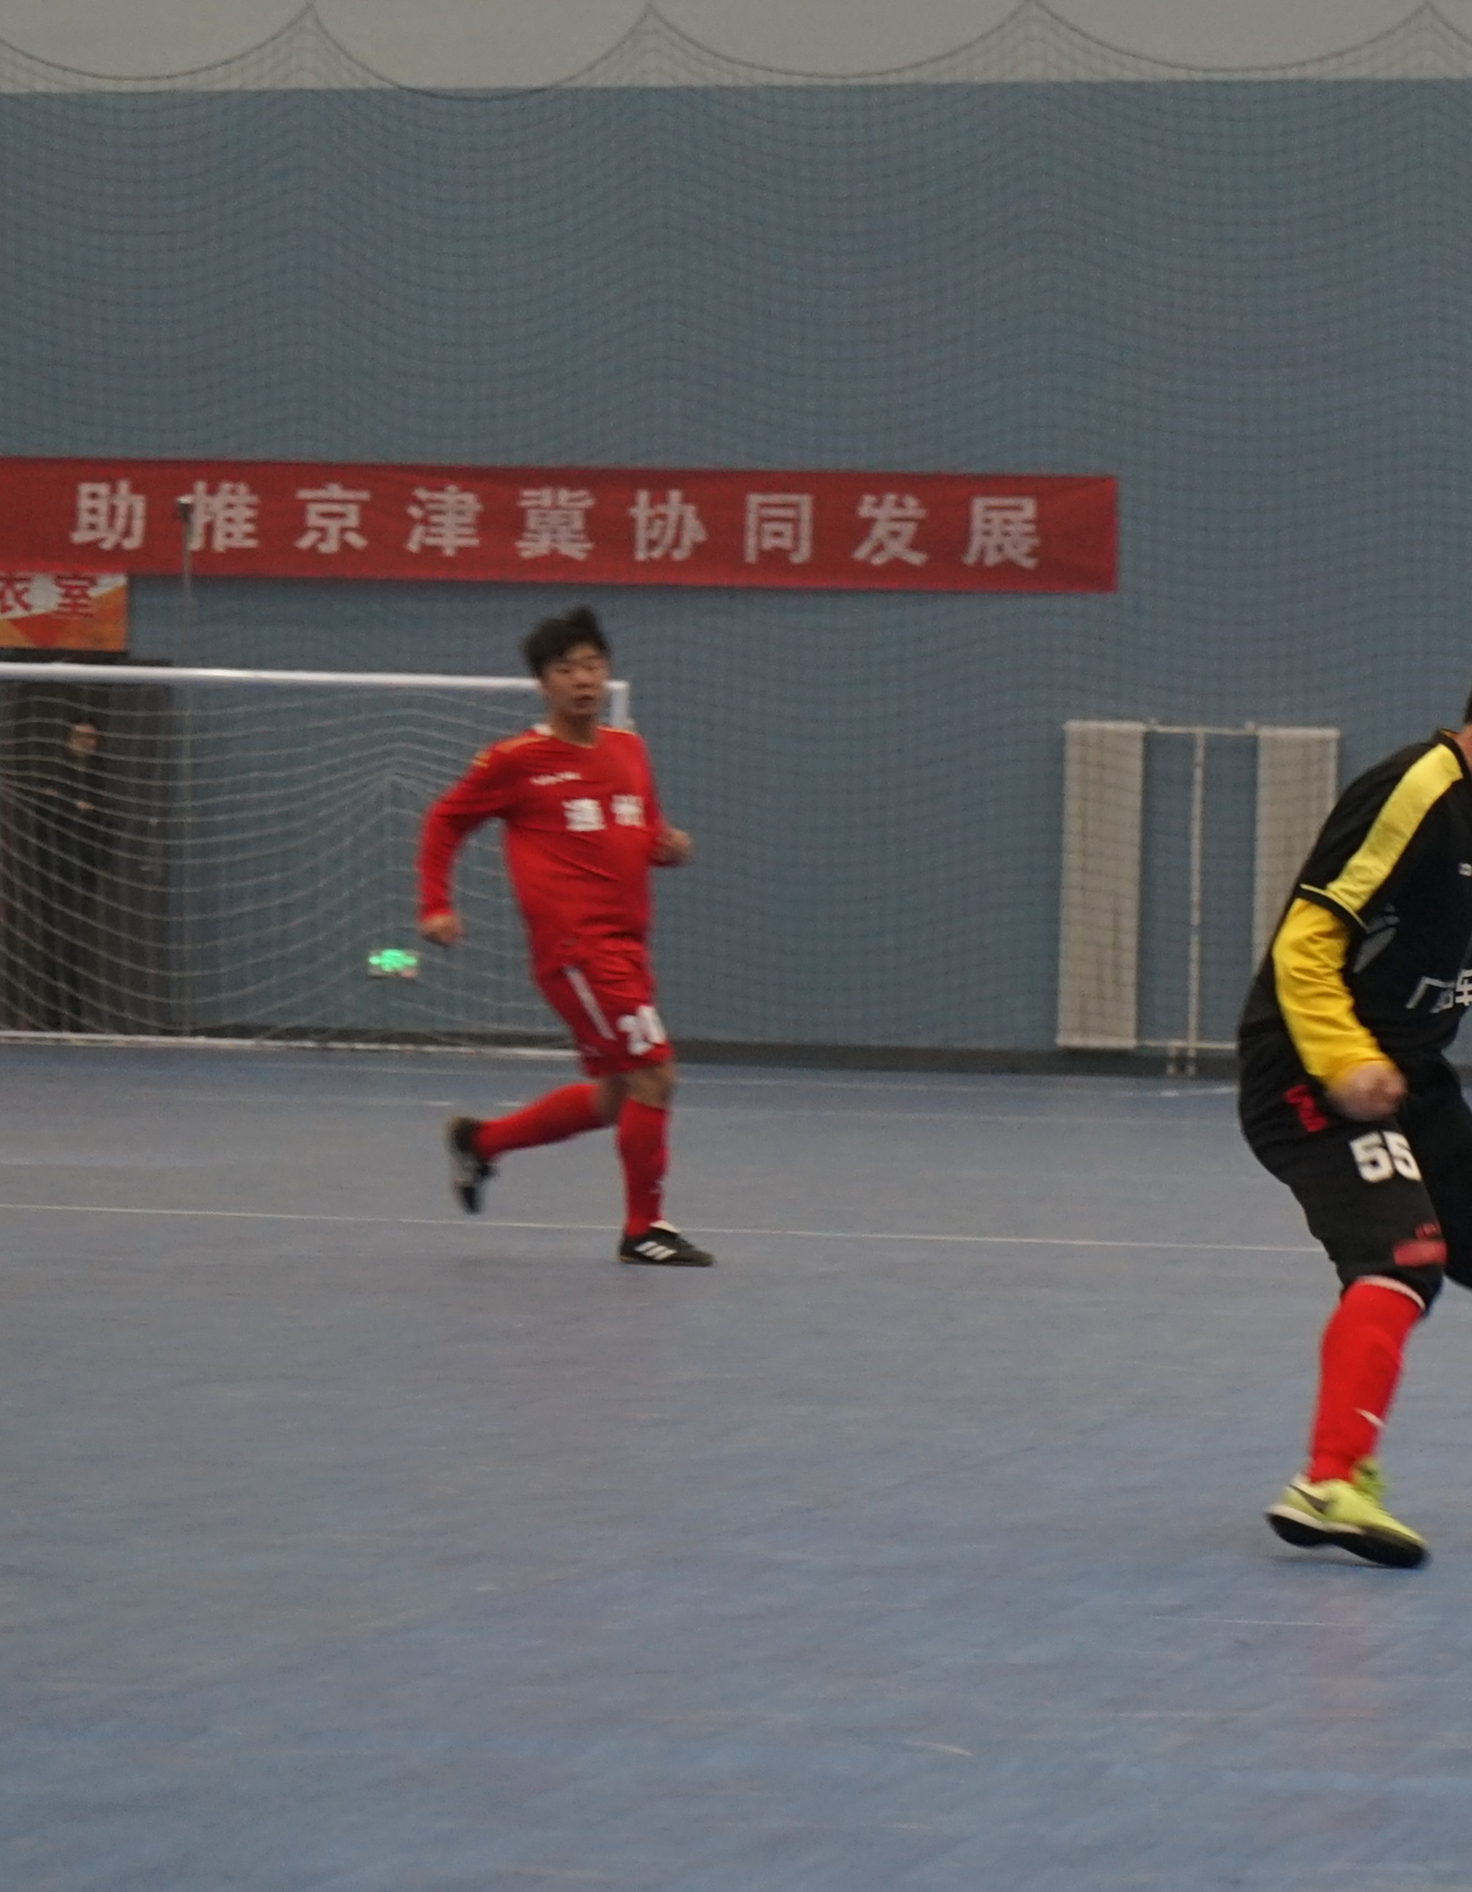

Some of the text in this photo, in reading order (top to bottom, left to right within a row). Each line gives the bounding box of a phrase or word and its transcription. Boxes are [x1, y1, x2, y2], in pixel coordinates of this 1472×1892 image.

[69, 479, 1041, 570] 助推京津冀协同发展
[1349, 1129, 1422, 1183] 55
